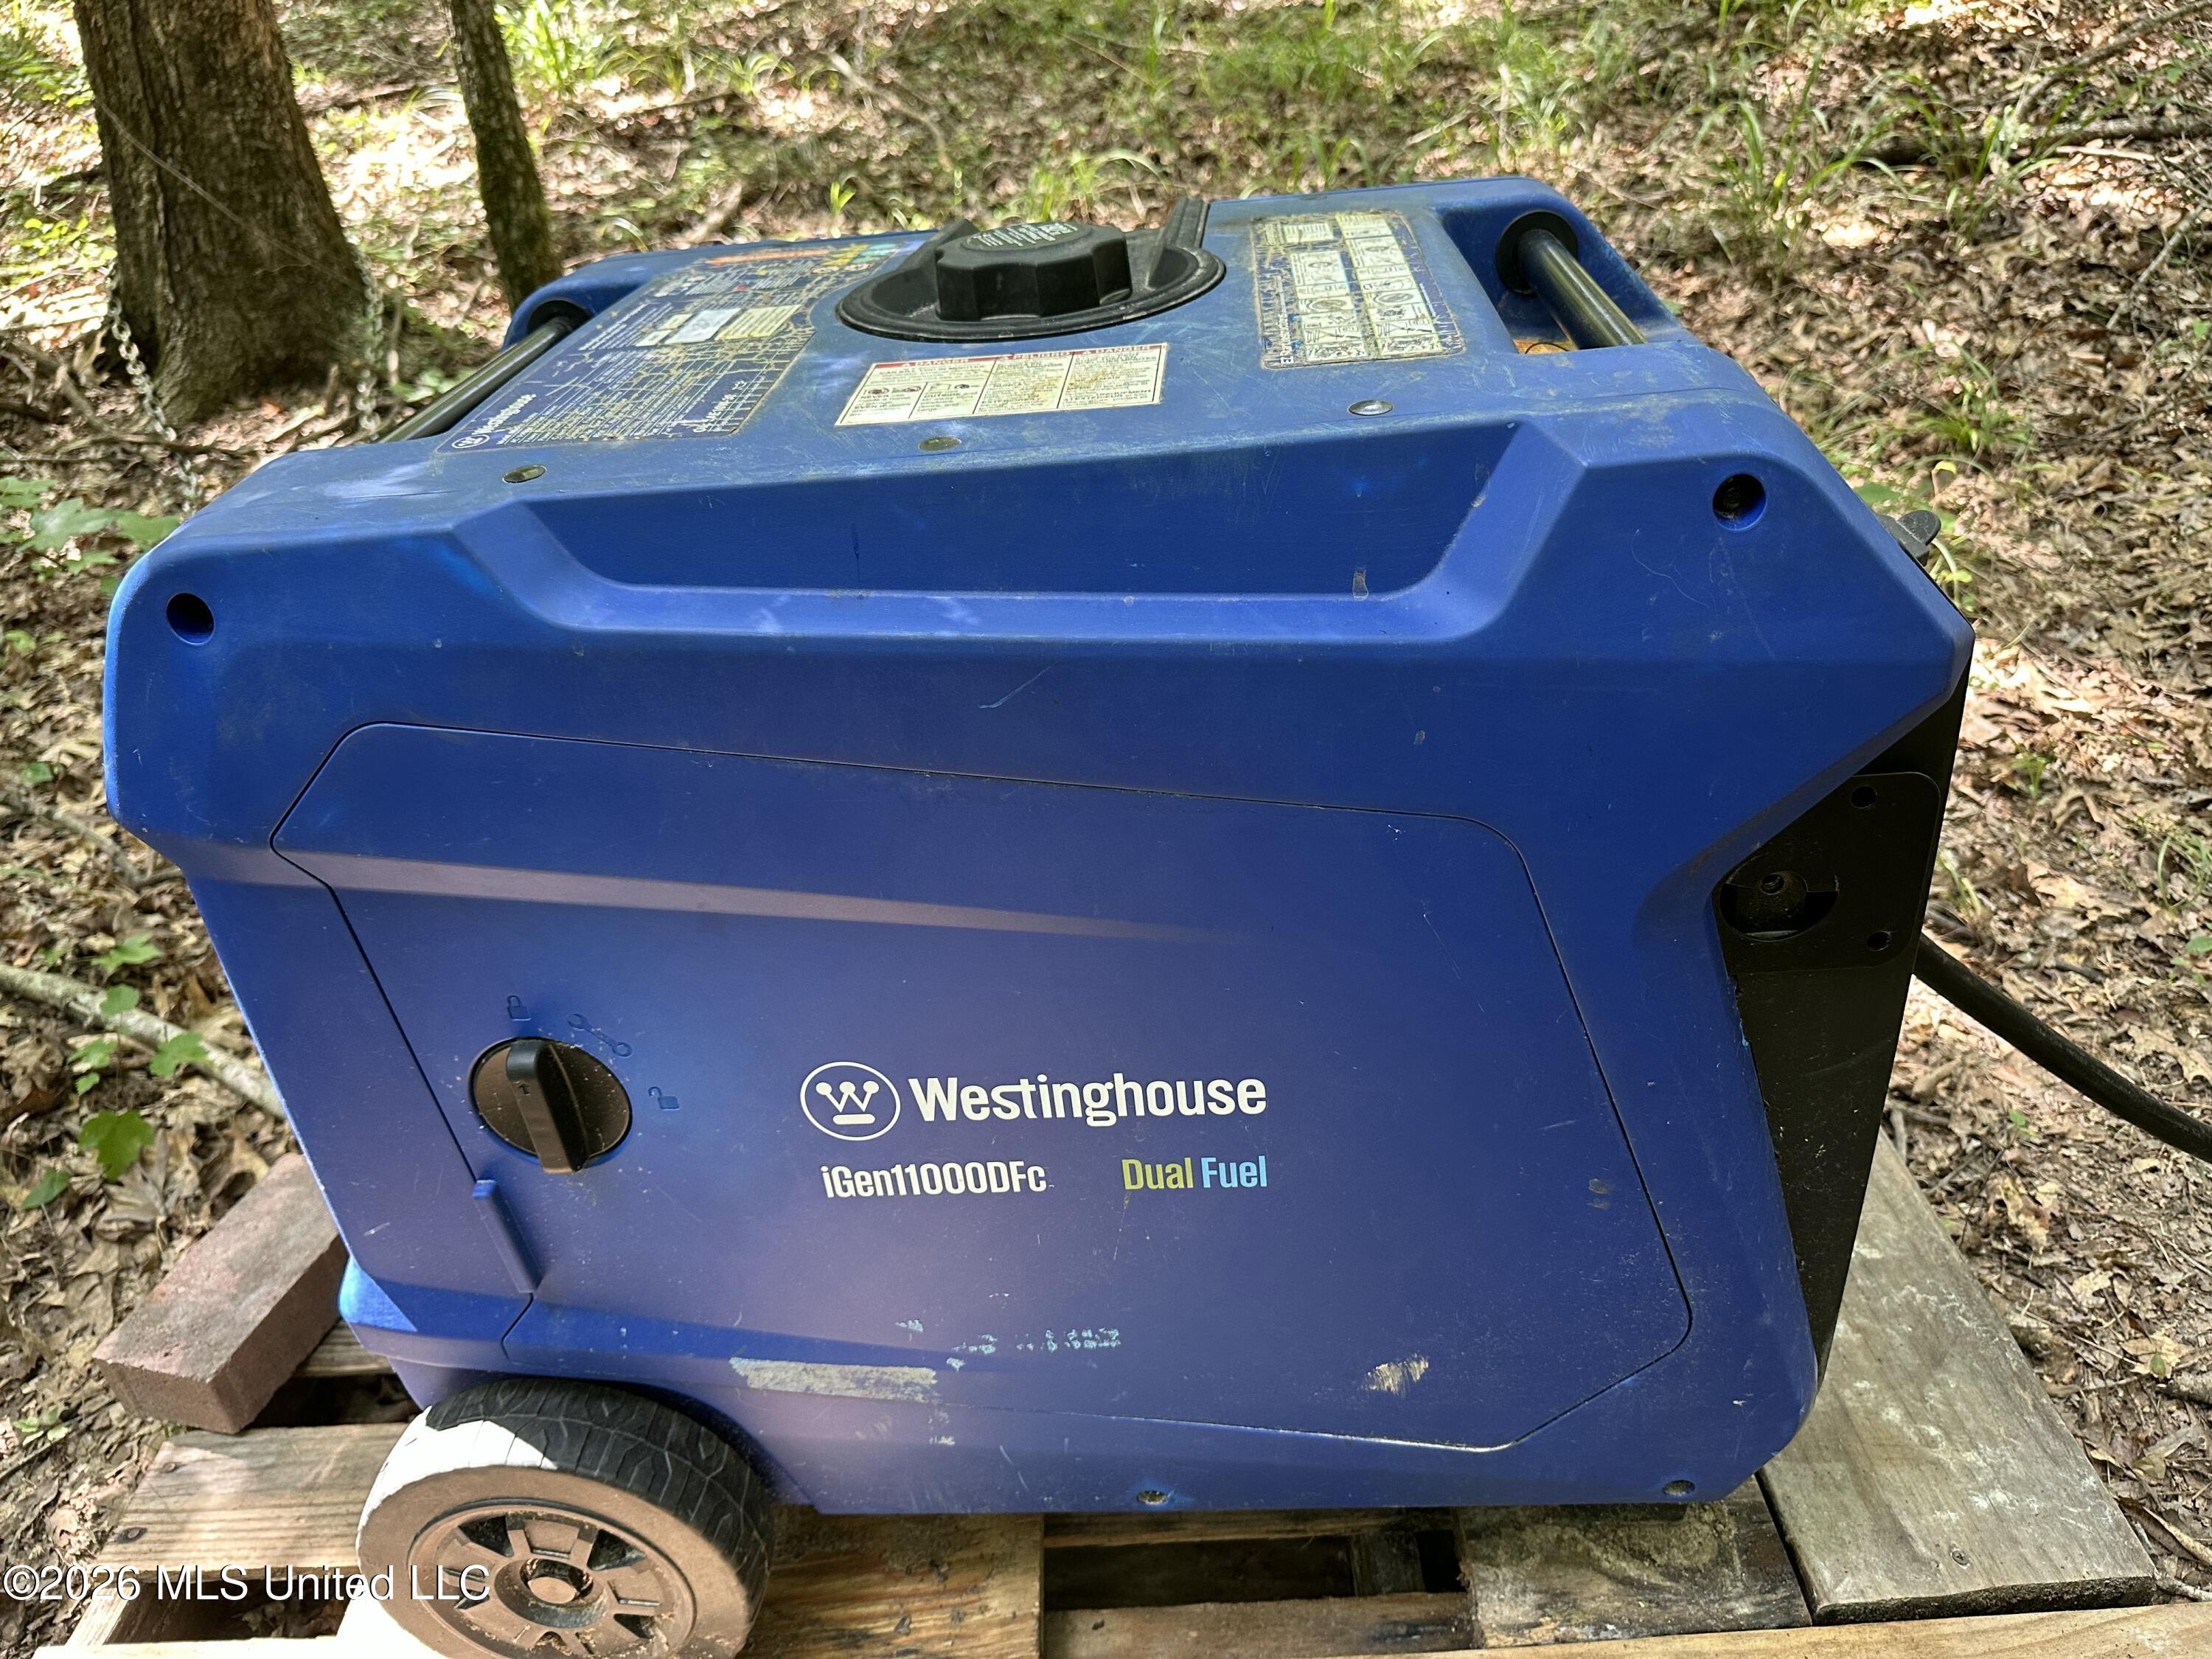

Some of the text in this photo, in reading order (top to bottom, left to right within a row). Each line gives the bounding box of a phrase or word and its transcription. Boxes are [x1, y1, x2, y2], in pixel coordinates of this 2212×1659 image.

[913, 358, 970, 366] DANGER
[908, 1073, 1267, 1127] Westinghouse
[820, 1160, 1048, 1198] iGen11000DFc
[1121, 1155, 1269, 1190] Dual Fuel
